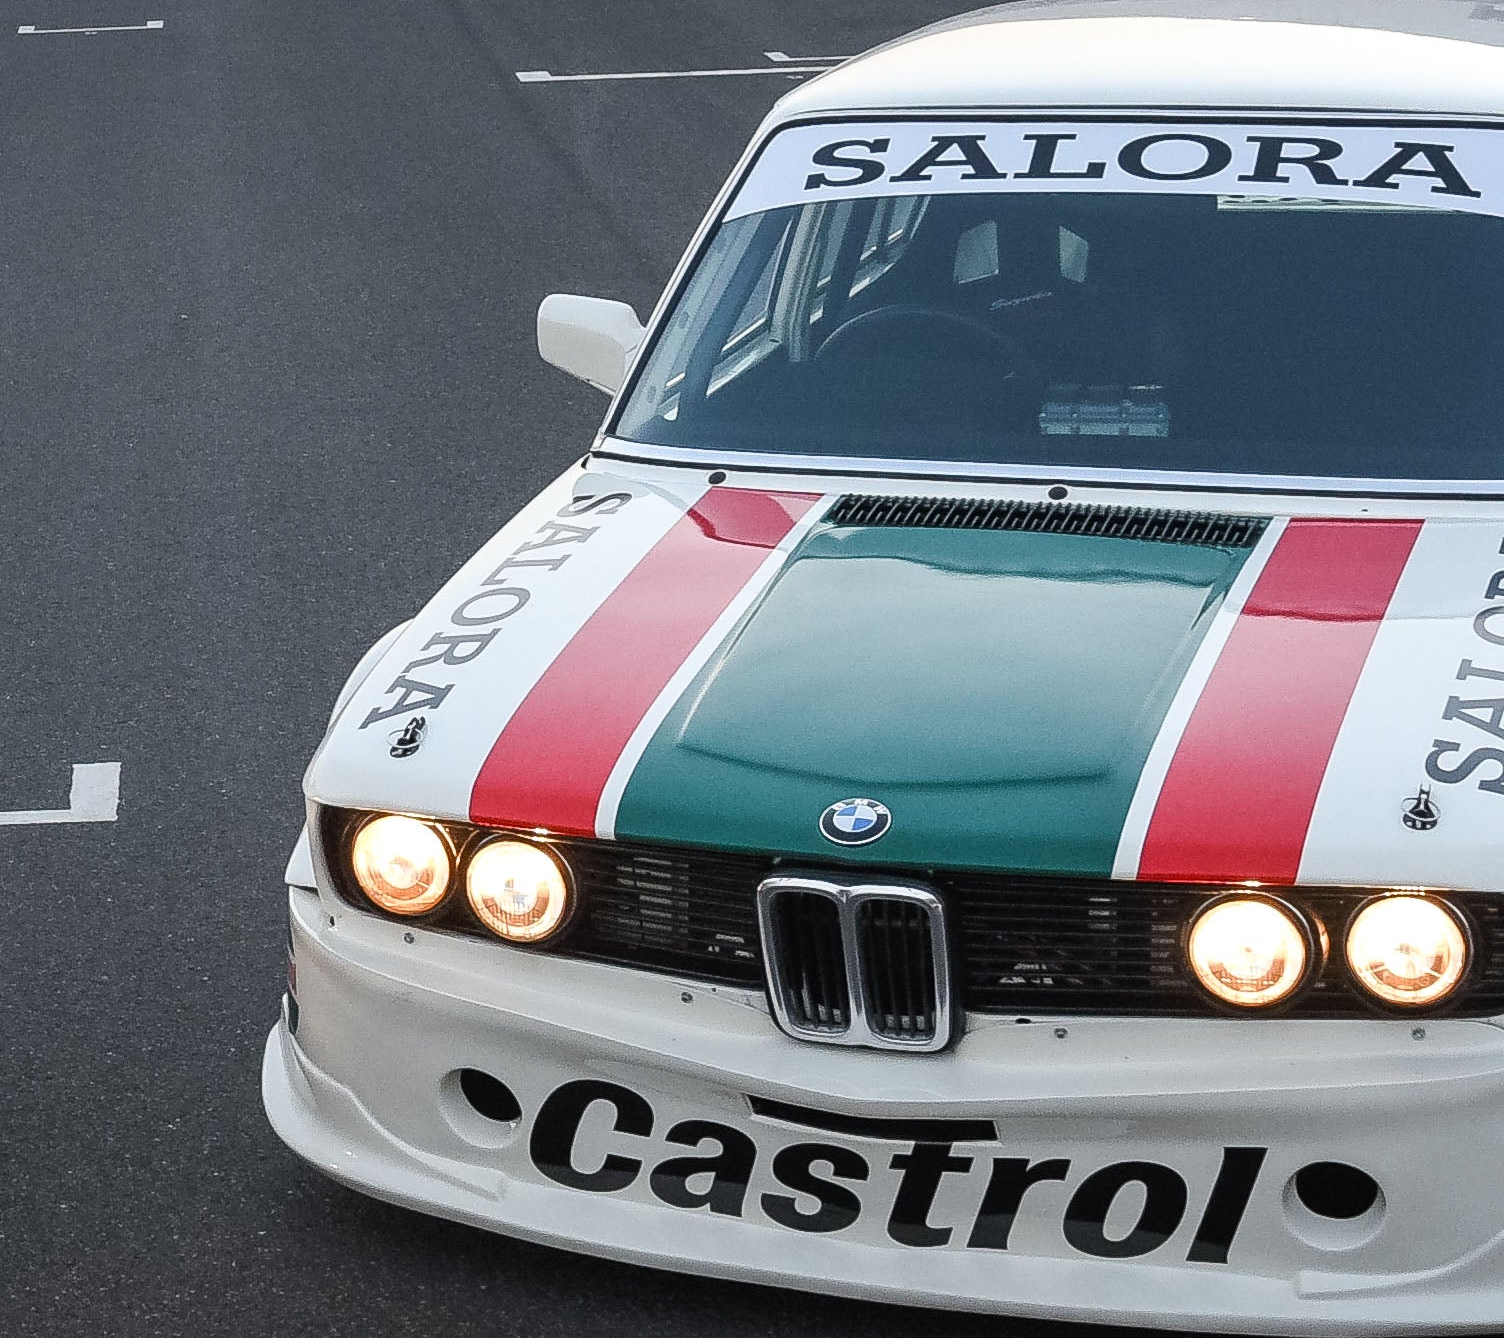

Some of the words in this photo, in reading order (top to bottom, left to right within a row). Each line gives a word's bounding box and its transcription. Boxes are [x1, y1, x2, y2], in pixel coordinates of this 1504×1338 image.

[804, 133, 1482, 199] SALORA
[359, 490, 635, 732] SALORA
[529, 1078, 1269, 1265] Castrol
